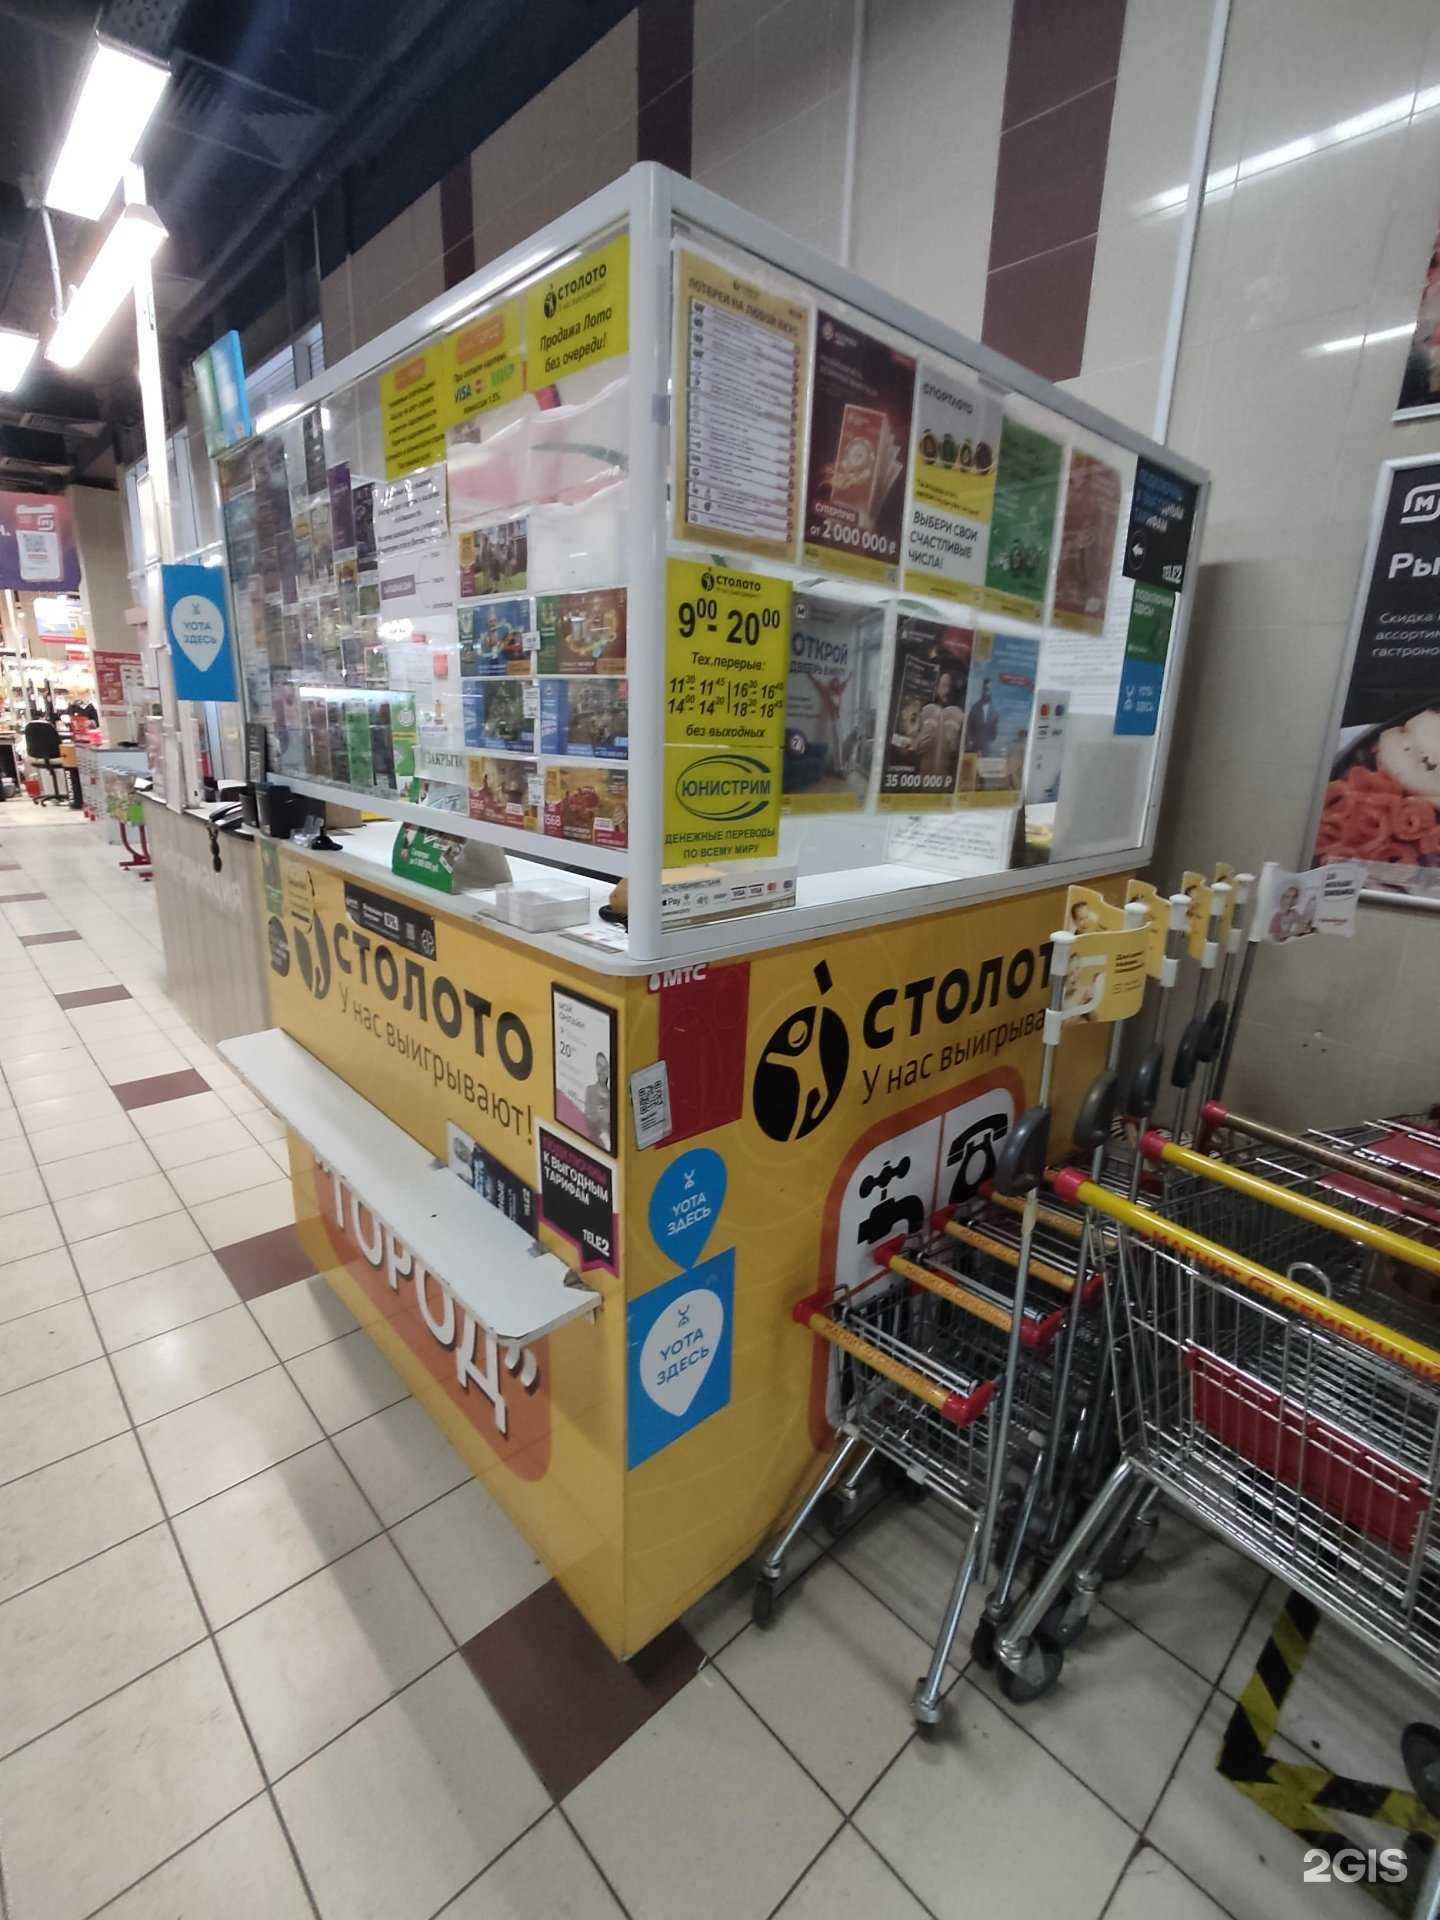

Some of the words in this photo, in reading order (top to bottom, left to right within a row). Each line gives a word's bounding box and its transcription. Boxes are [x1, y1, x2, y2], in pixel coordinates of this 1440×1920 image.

[545, 357, 560, 373] без
[913, 511, 951, 534] ВЫБЕРИ
[910, 530, 972, 558] СЧАСТЛИВЫЕ
[1380, 612, 1433, 624] Скидка
[686, 725, 705, 737] без
[709, 726, 765, 738] выходных
[682, 780, 771, 797] ЮНИСТРИМ
[665, 831, 722, 844] ДЕНЕЖНЫЕ
[725, 827, 775, 840] ПЕРЕВОДЫ
[684, 849, 697, 859] ПО
[701, 846, 732, 858] ВСЕМУ
[663, 963, 706, 988] МТС
[332, 922, 533, 1081] СТОЛОТО
[863, 941, 1054, 1050] СТОЛОТ
[887, 1053, 933, 1094] нас
[939, 1009, 1045, 1072] выигрыва
[353, 1007, 383, 1038] нас
[386, 1022, 534, 1146] выигрывают!
[543, 1151, 551, 1166] К
[551, 1156, 608, 1202] ВЫГОДНЫМ
[545, 1167, 589, 1205] ТАРИФАМ
[672, 1192, 707, 1216] YOTA
[667, 1207, 712, 1236] ЗДЕСЬ
[582, 1229, 610, 1256] TELE2
[660, 1328, 705, 1361] YOTA
[657, 1347, 709, 1386] ЗДЕСЬ
